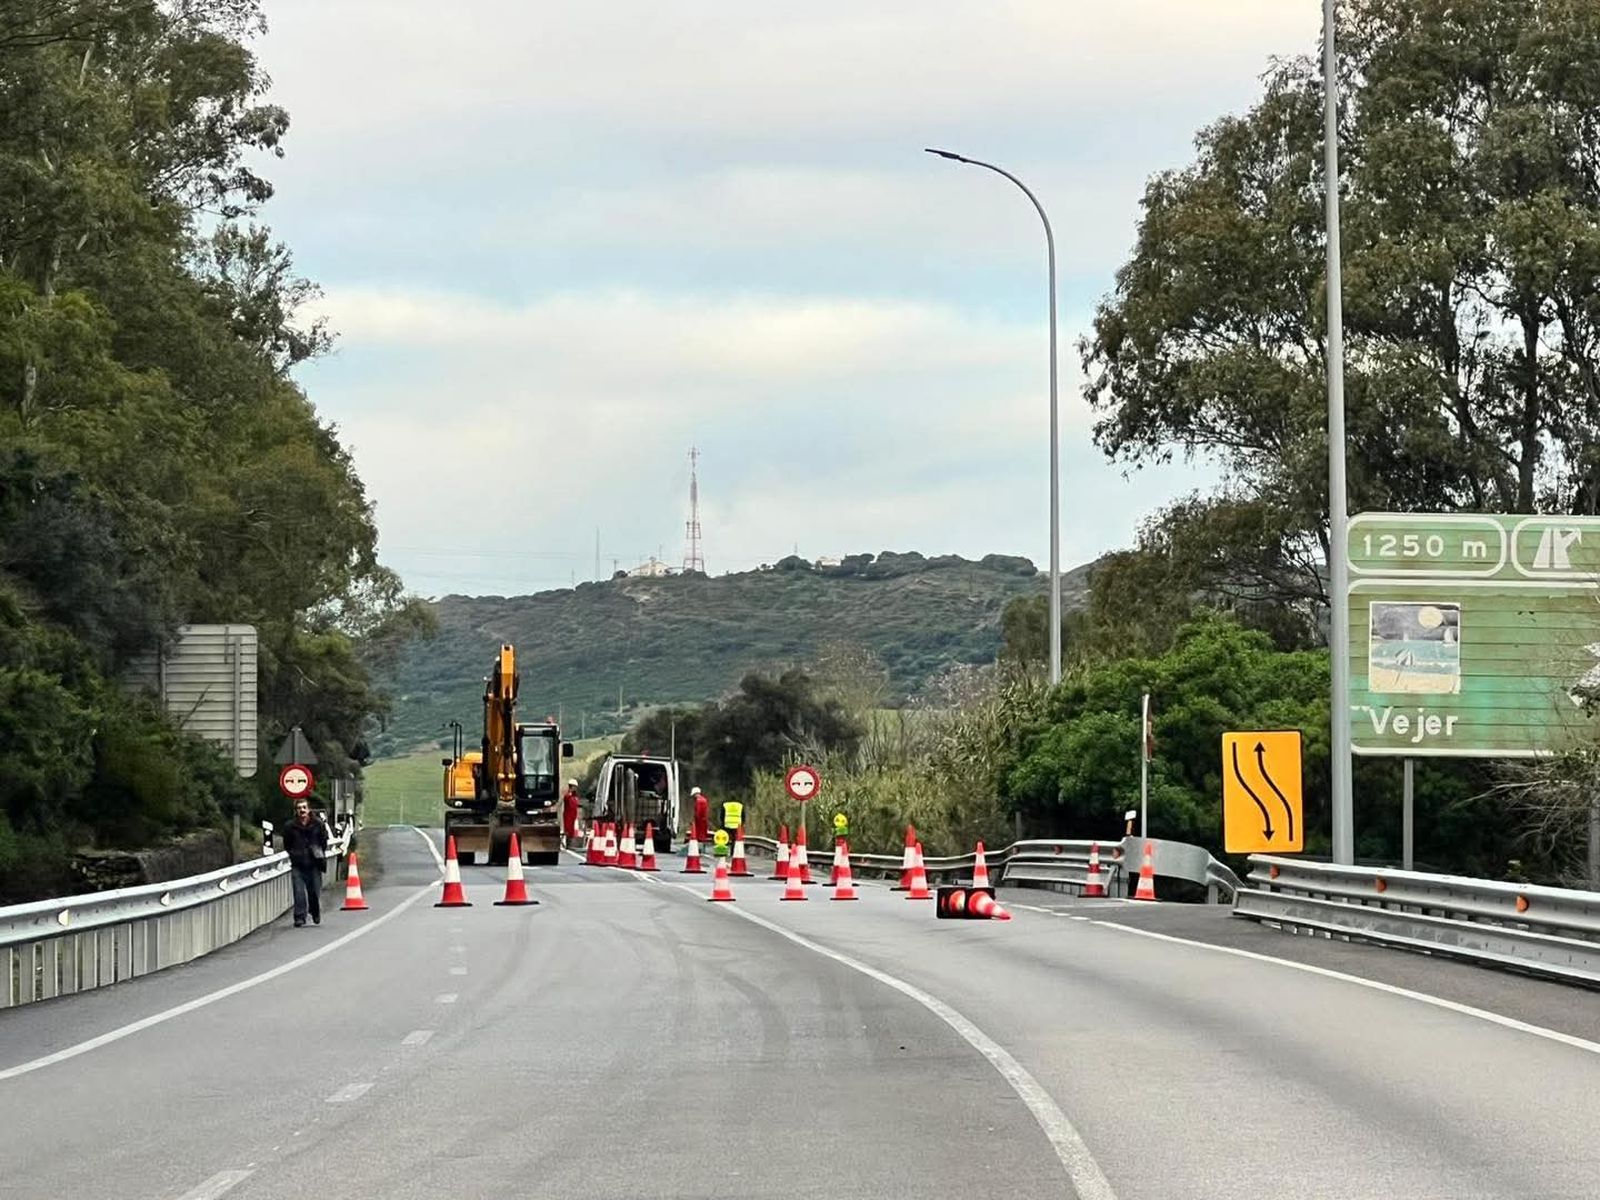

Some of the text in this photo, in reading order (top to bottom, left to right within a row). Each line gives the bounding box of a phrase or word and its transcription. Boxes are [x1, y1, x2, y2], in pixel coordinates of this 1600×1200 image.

[1363, 534, 1487, 558] 1250 m
[1366, 706, 1459, 743] Vejer
